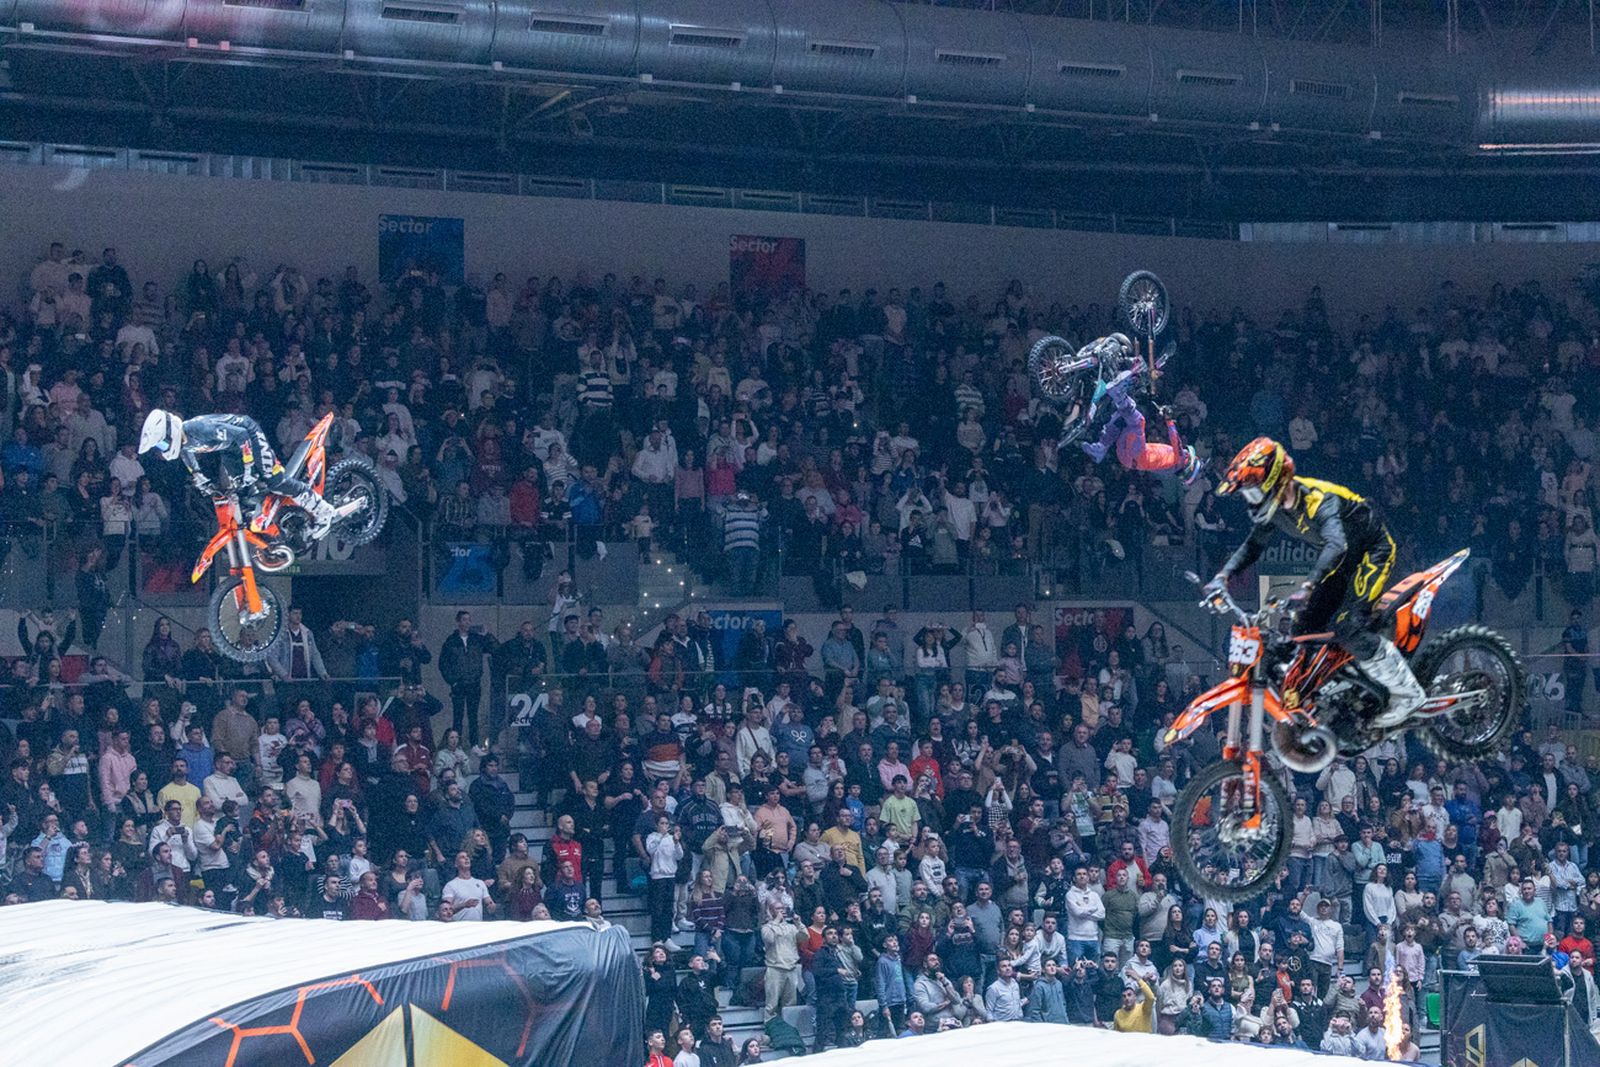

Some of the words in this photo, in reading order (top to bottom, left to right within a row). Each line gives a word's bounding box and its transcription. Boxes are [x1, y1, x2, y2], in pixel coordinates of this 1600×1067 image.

[379, 214, 433, 233] Sector
[730, 235, 778, 252] Sector
[1055, 609, 1094, 626] Secto
